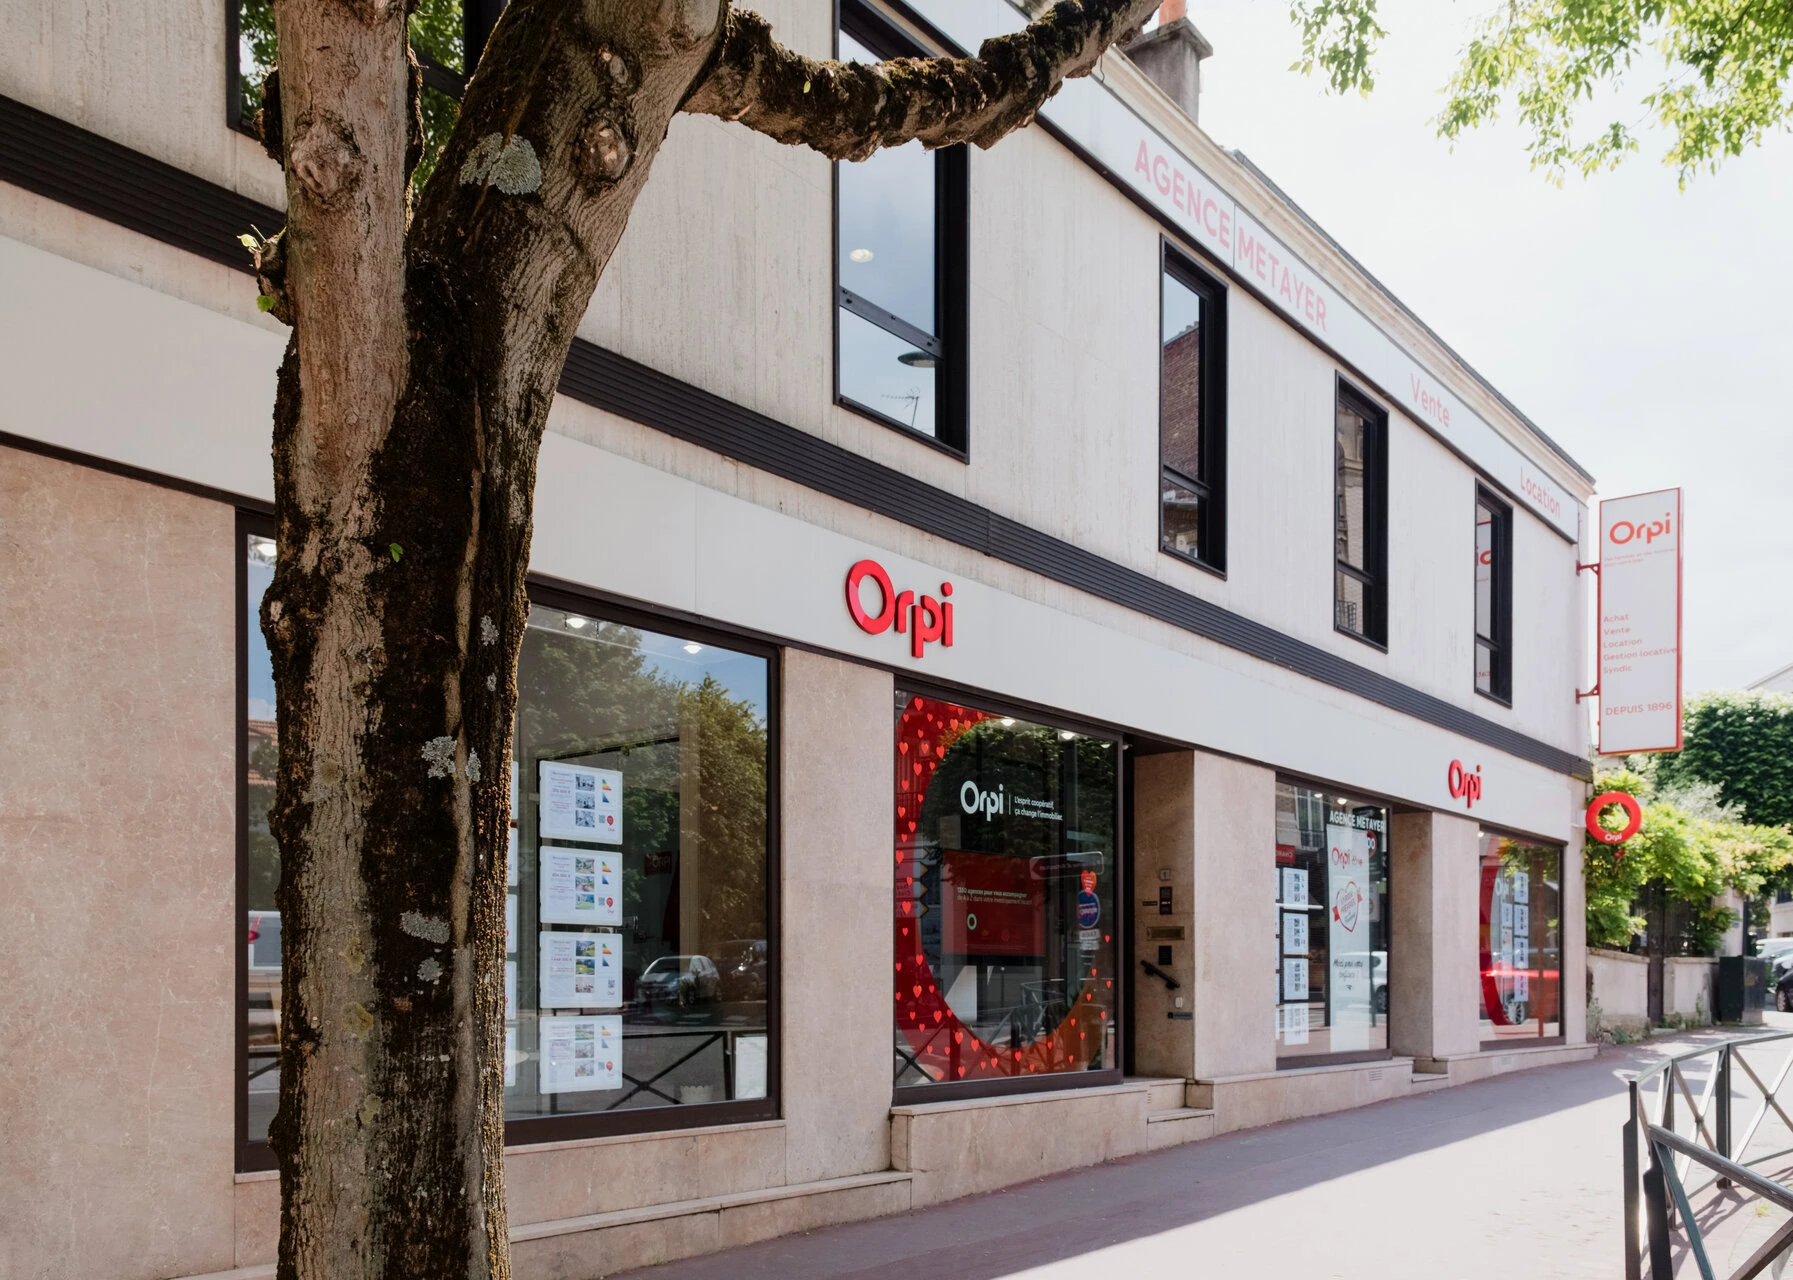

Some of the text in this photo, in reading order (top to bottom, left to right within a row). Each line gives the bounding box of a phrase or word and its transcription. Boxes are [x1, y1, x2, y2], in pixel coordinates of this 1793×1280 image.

[1134, 139, 1328, 333] AGENCE METAYER
[1410, 373, 1450, 429] Vente
[1520, 466, 1561, 519] Location
[1609, 511, 1671, 545] Orpi
[844, 559, 953, 658] Orpi
[1603, 614, 1629, 623] Achat
[1603, 627, 1631, 636] Vente
[1603, 638, 1643, 649] Location
[1603, 652, 1638, 662] Gestion
[1603, 664, 1633, 675] Syndic
[1605, 701, 1673, 716] DEPUIS 1896
[1448, 759, 1482, 809] Orpi
[960, 780, 1004, 822] Orpi
[1329, 810, 1385, 833] AGENCE METAYER
[1604, 832, 1623, 842] Orpi
[1331, 846, 1351, 870] Orpi
